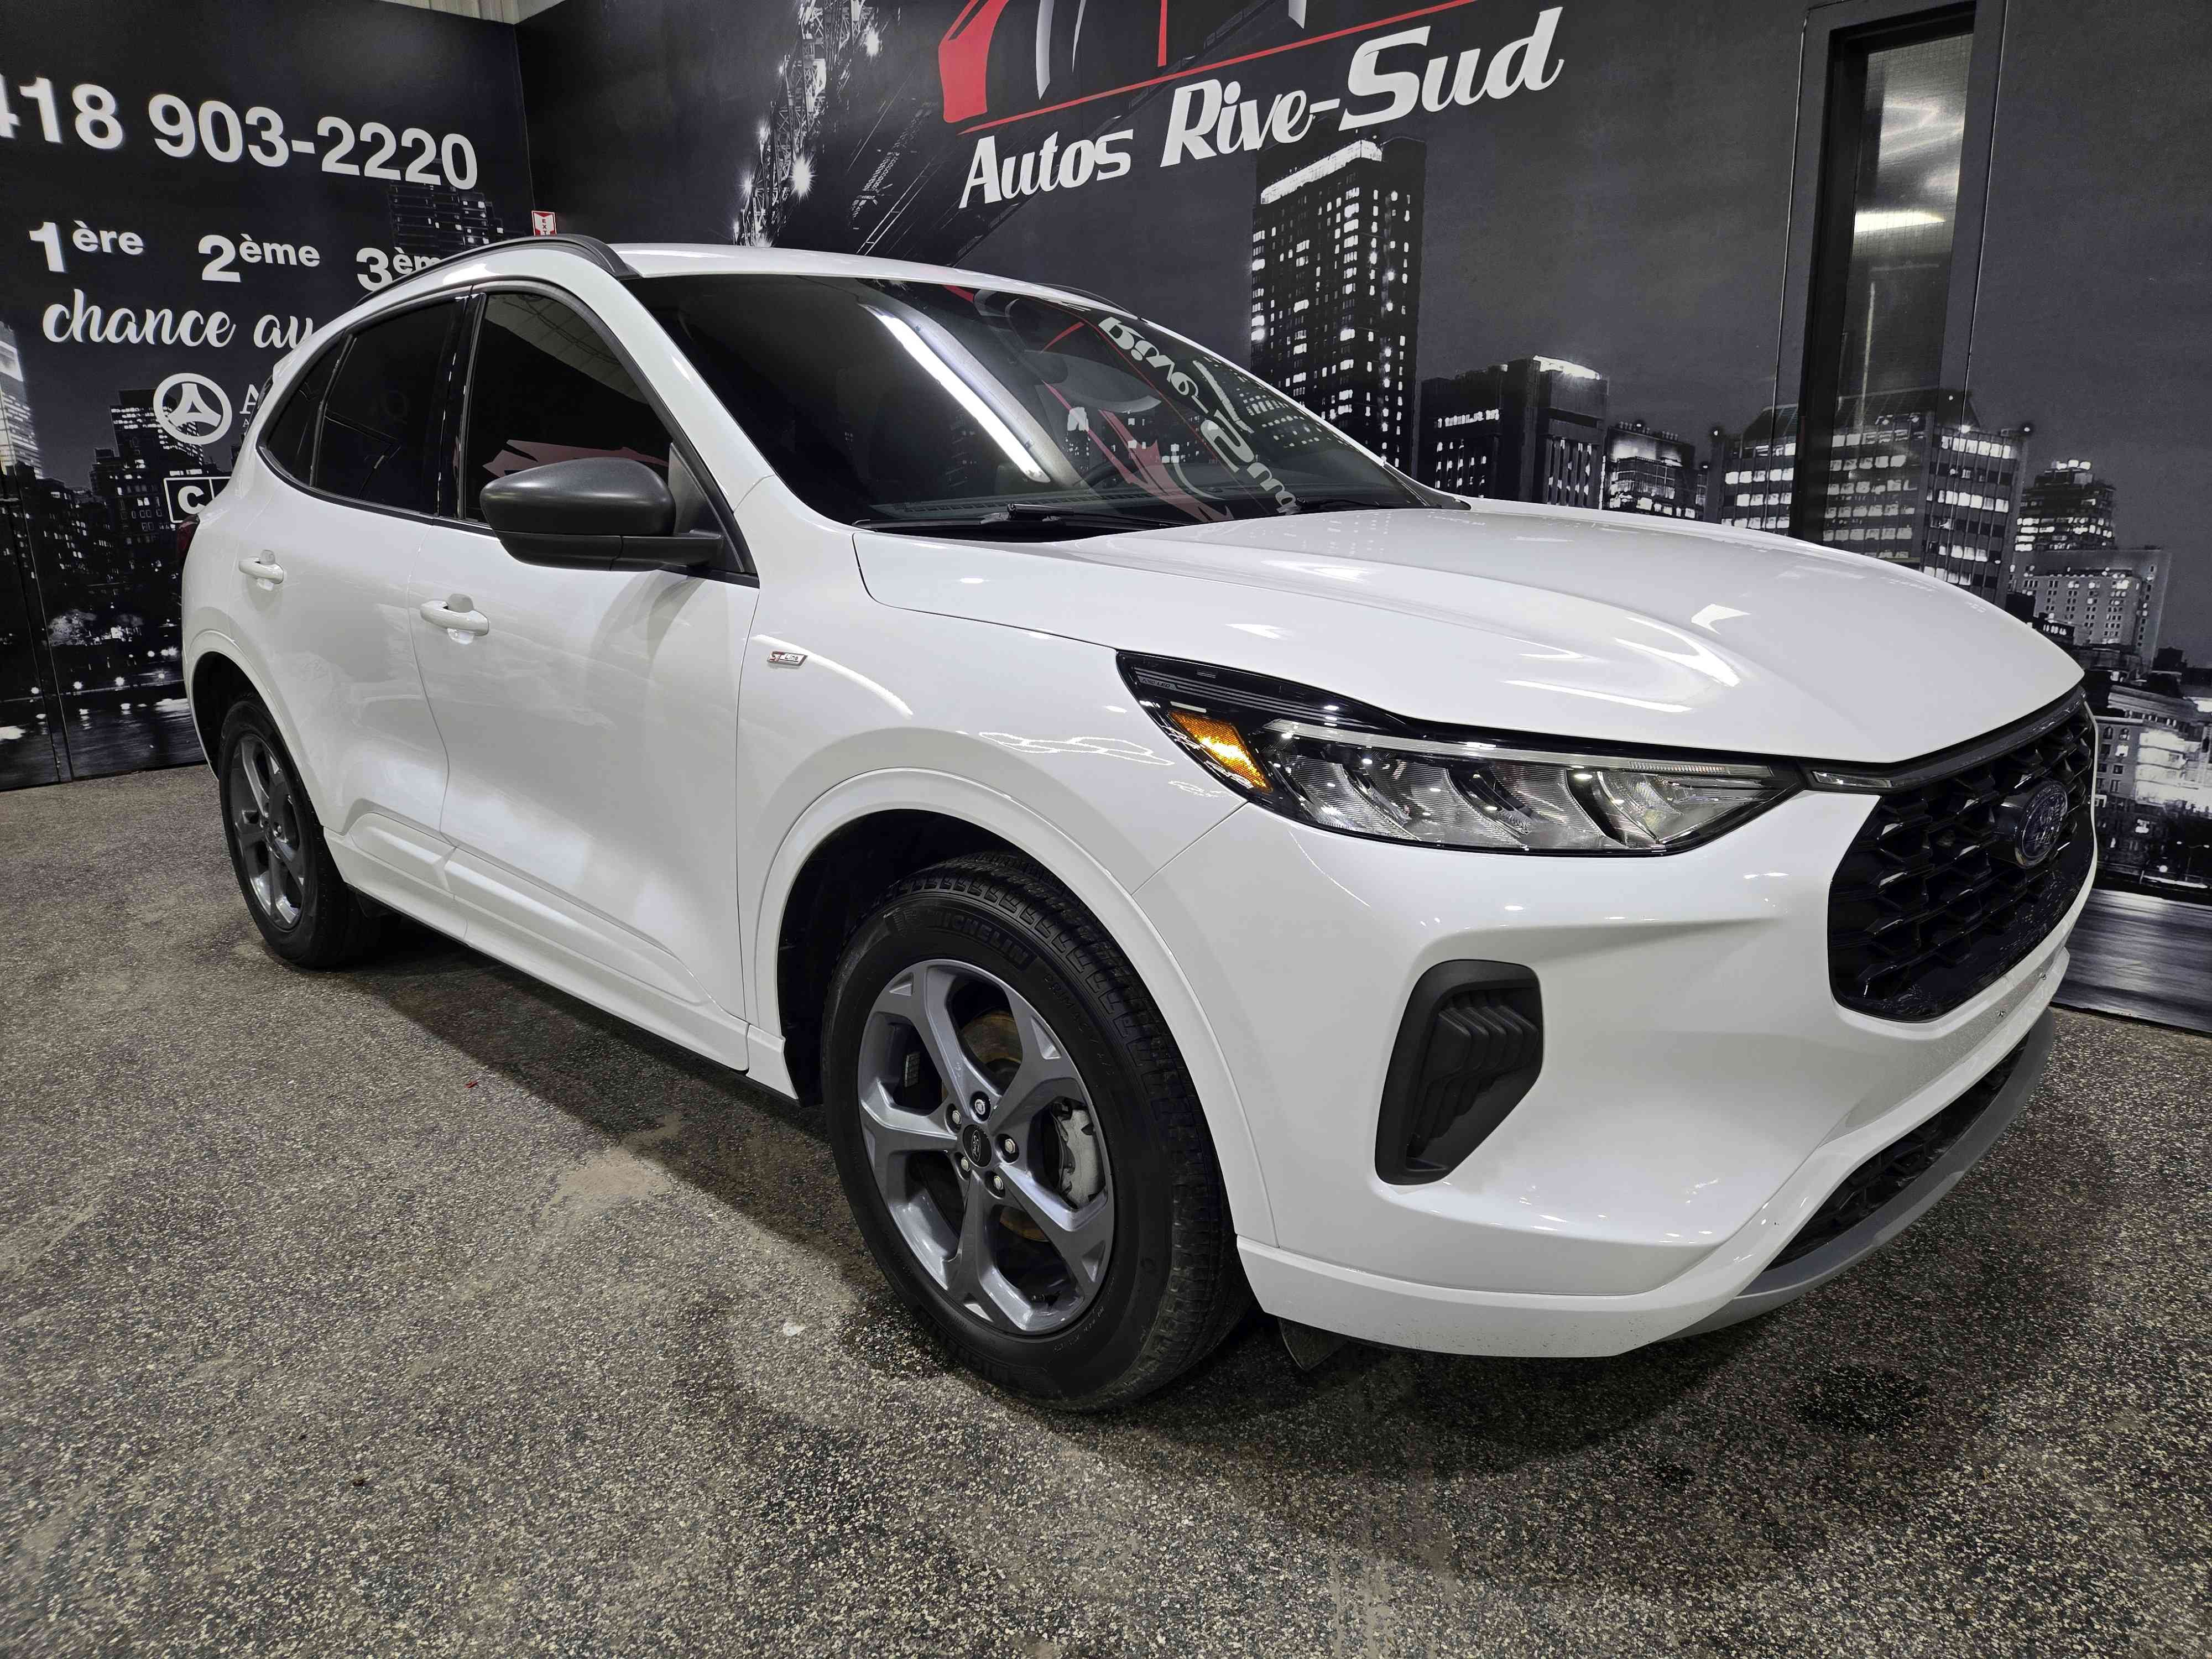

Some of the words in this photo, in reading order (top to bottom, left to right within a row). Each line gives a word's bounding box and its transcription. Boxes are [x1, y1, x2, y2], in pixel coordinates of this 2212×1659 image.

[148, 93, 478, 190] 903-2220
[958, 129, 1134, 208] Autos
[1160, 7, 1564, 168] Rive-Sud
[29, 220, 144, 272] 1ère
[198, 233, 320, 283] 2ème
[43, 288, 236, 347] chance
